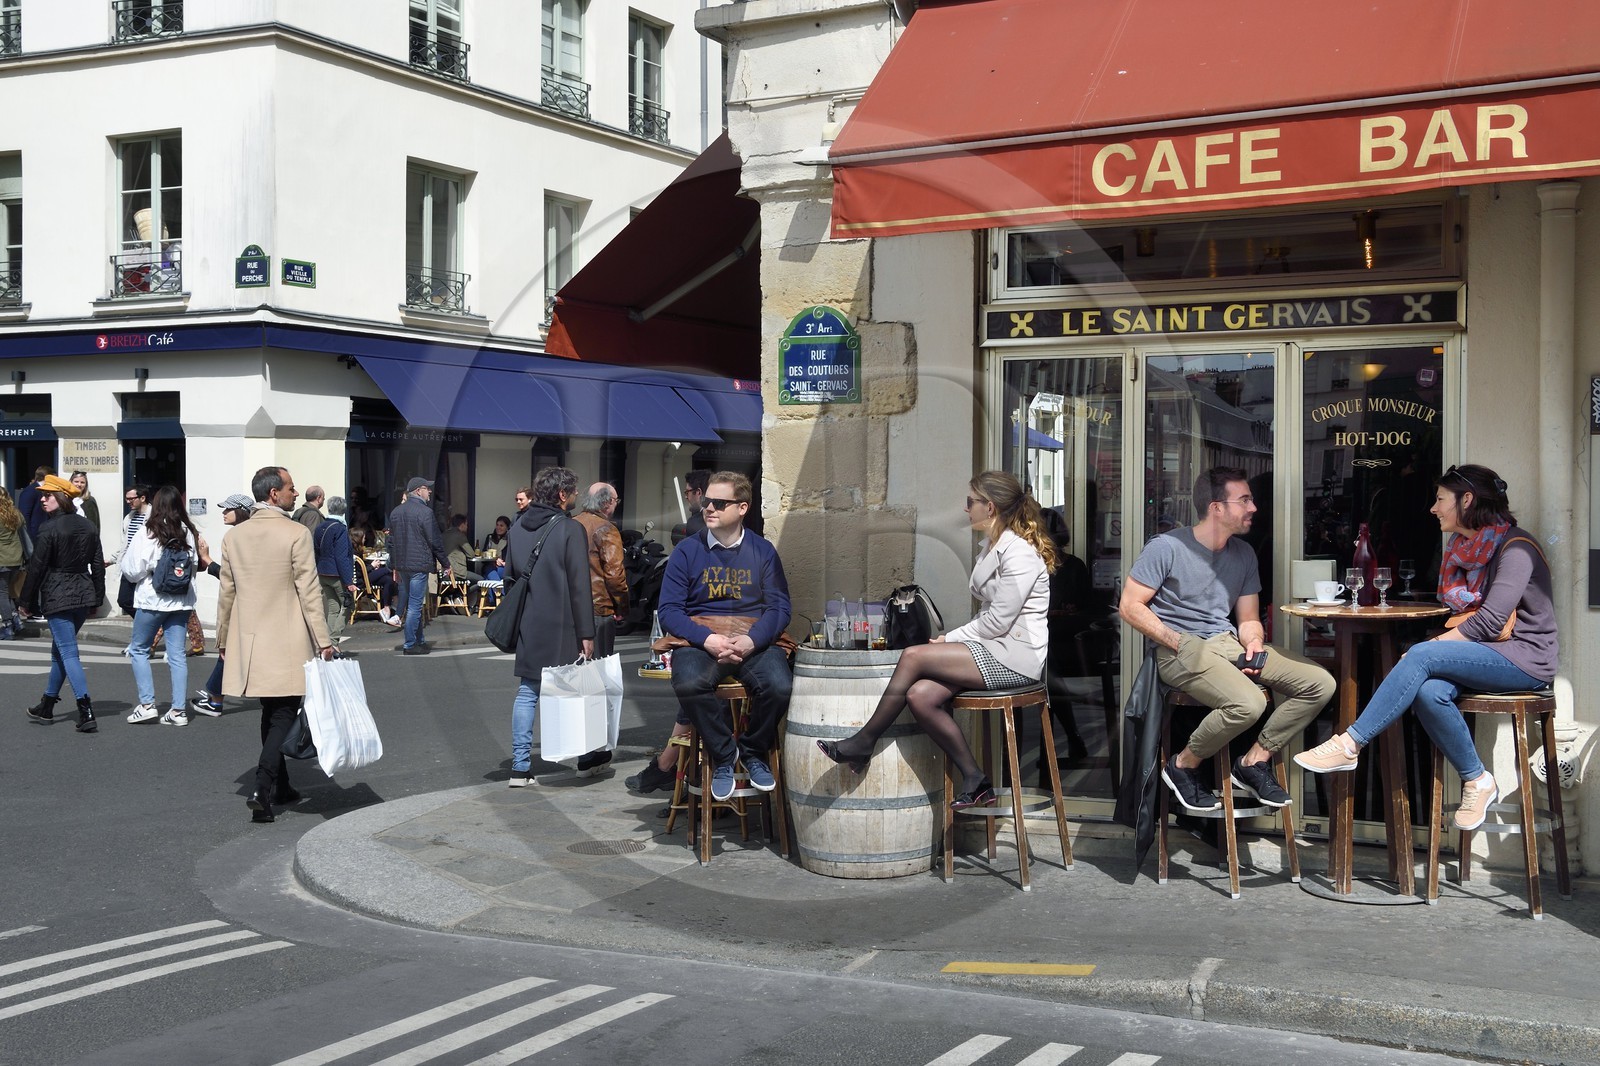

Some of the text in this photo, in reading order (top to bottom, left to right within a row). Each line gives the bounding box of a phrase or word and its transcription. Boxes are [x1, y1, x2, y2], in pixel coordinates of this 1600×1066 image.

[1091, 103, 1529, 197] CAFE BAR
[1062, 297, 1372, 335] LE SAINT GERVAIS
[110, 332, 174, 347] BREIZH Café
[810, 349, 827, 361] RUE
[788, 364, 850, 377] DES COUTURES
[1311, 397, 1437, 424] CROQUE MONSIEUR
[412, 433, 464, 442] AUTREMENT
[1334, 431, 1411, 446] HOT-DOG
[75, 441, 107, 451] TIMBRES
[90, 455, 119, 466] TIMBRES
